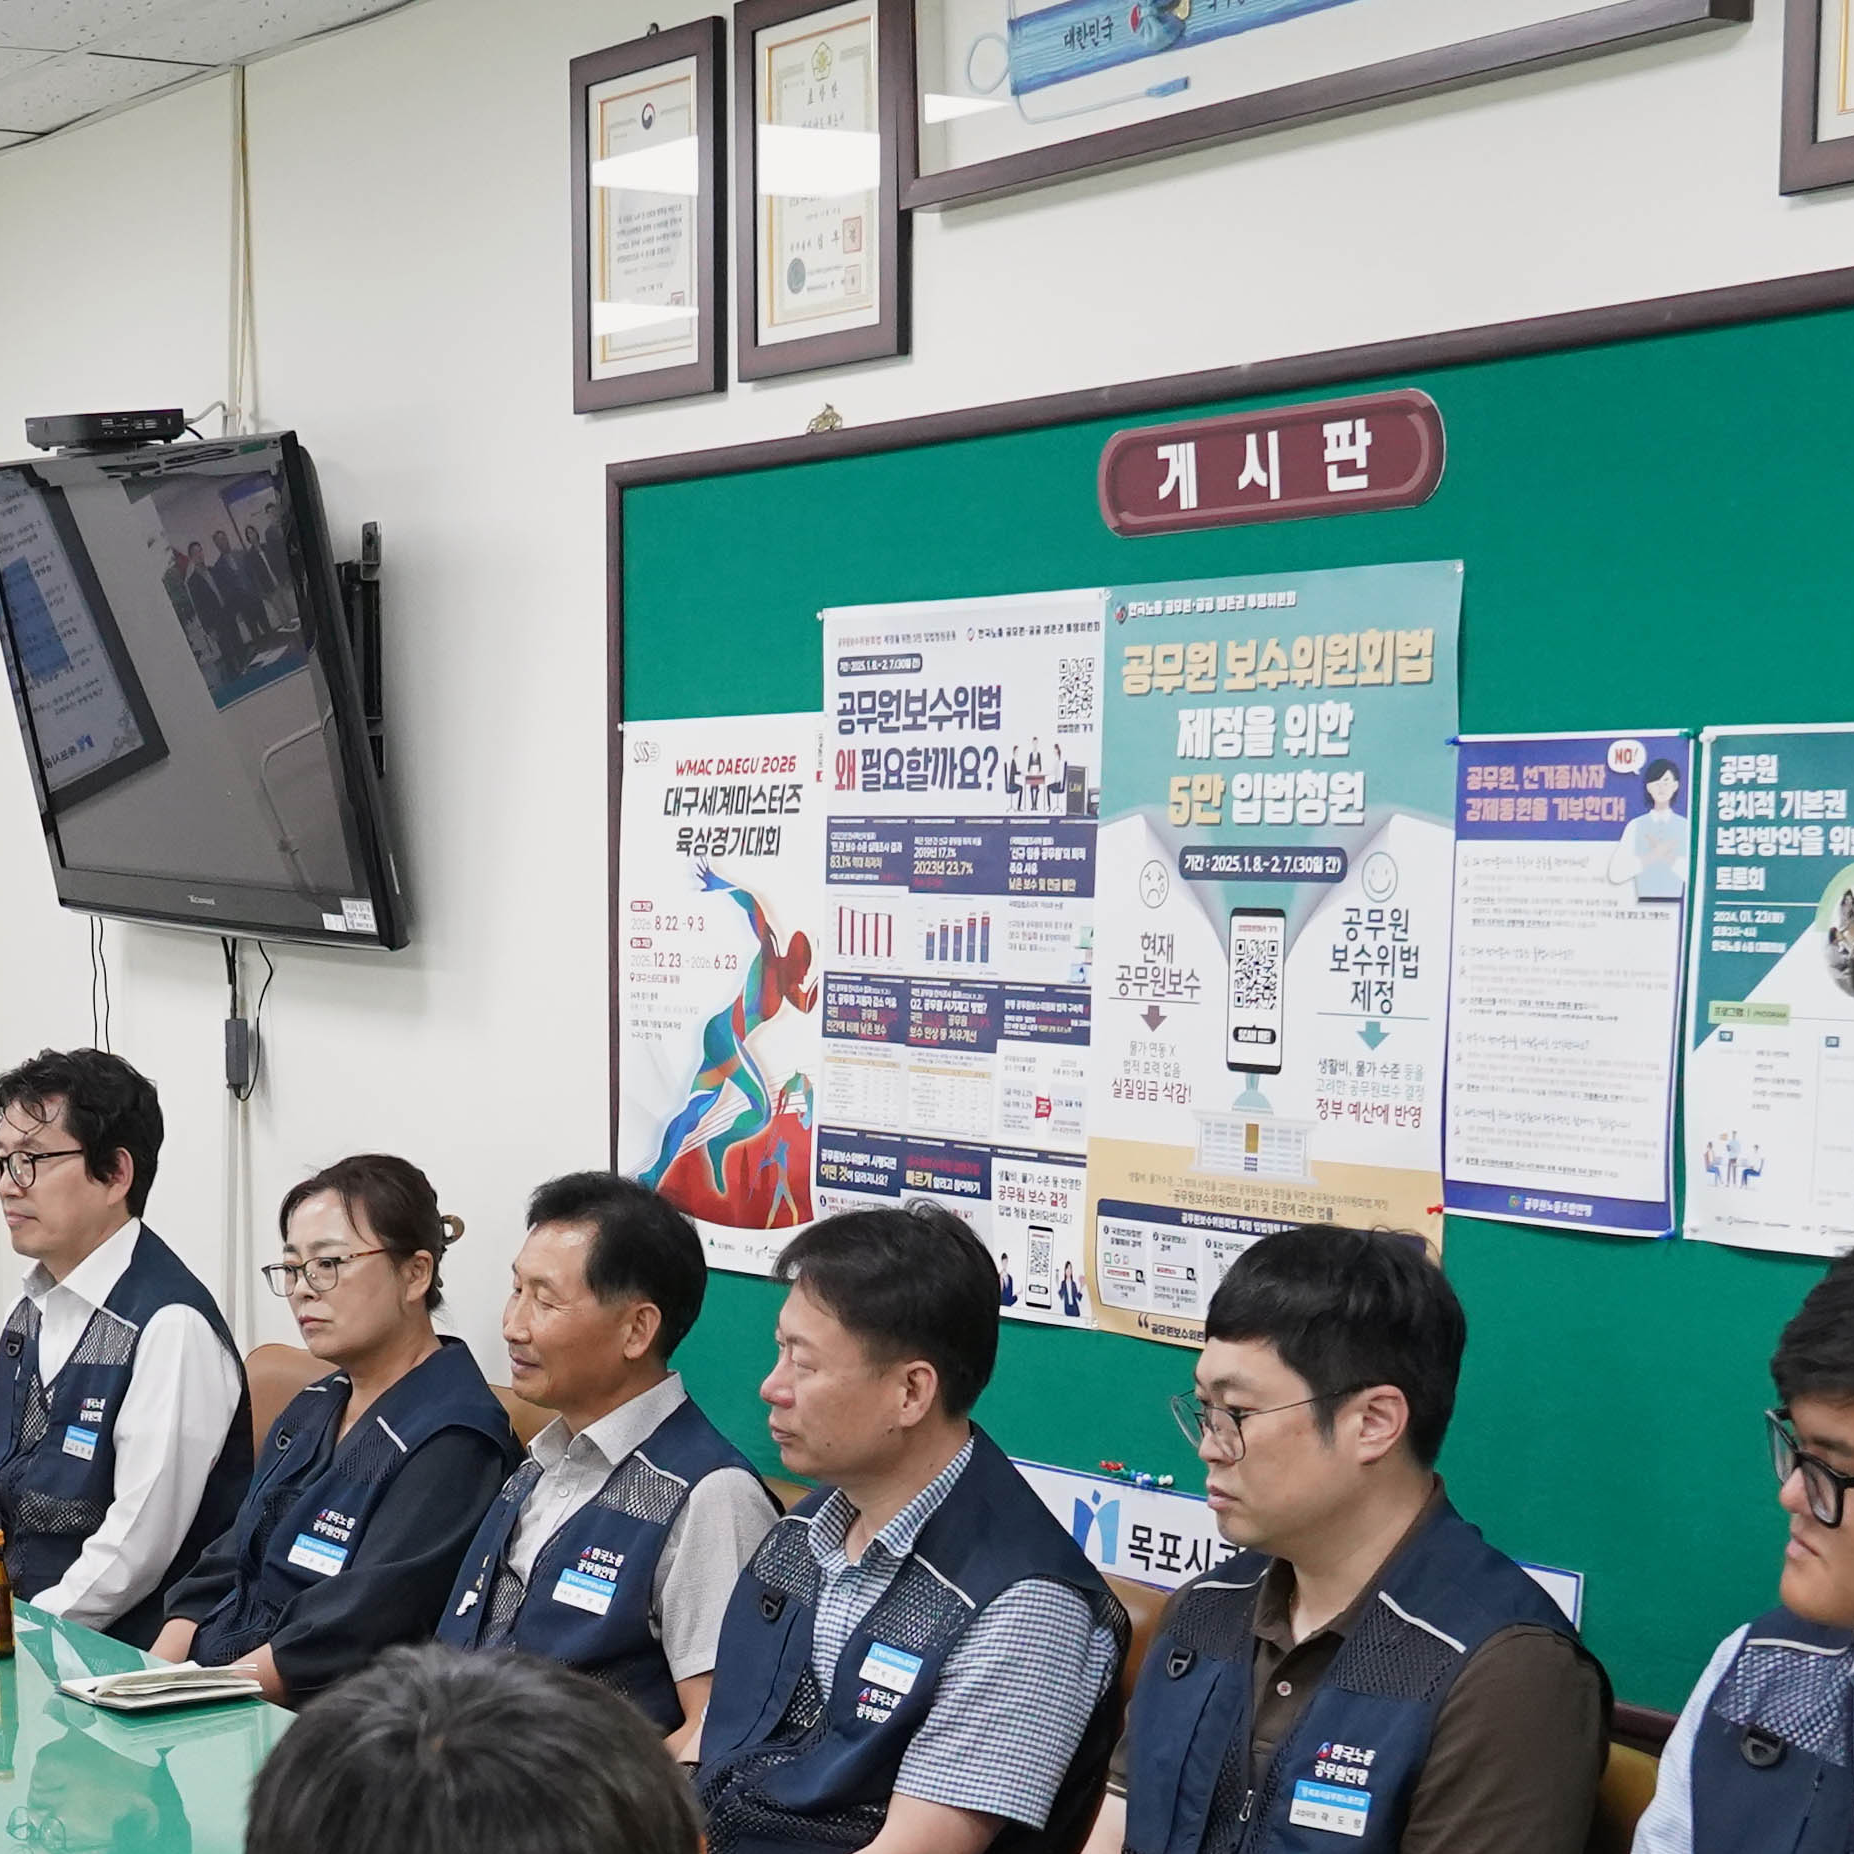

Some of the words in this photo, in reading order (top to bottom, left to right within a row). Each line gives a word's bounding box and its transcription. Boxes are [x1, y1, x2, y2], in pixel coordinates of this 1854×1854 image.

[1062, 15, 1115, 50] 대한민국
[1157, 426, 1374, 513] 게시판
[1121, 641, 1218, 695] 공무원
[1224, 628, 1434, 691] 보수위원회법
[837, 685, 1002, 735] 공무원보수위법
[1176, 705, 1276, 758] 제정을
[1282, 700, 1354, 758] 위한
[675, 758, 713, 776] WMAC
[716, 757, 760, 775] DAEGU
[762, 755, 797, 773] 2026
[835, 748, 856, 792] 왜
[861, 745, 999, 792] 필요할까요?
[1466, 765, 1520, 792] 공무원,
[1720, 754, 1779, 786] 공무원
[664, 784, 803, 816] 대구세계마스터즈
[1168, 773, 1226, 826] 5만
[1231, 769, 1365, 824] 입법청원
[1553, 797, 1626, 822] 거부한다!
[1717, 790, 1776, 821] 정치적
[1780, 789, 1847, 820] 기본권
[676, 826, 782, 857] 육상경기대회
[1716, 825, 1825, 857] 보장방안을
[1715, 866, 1766, 891] 토론회
[1342, 907, 1410, 943] 공무원
[1140, 931, 1174, 964] 현재
[1329, 944, 1420, 980] 보수위법
[1115, 964, 1201, 1000] 공무원보수
[1350, 980, 1395, 1015] 제정
[1379, 1061, 1401, 1080] 수준
[1111, 1078, 1159, 1102] 실질임금
[1163, 1082, 1192, 1105] 삭감!
[1316, 1097, 1343, 1122] 정부
[1346, 1101, 1390, 1126] 예산에
[1394, 1104, 1422, 1128] 반영
[998, 1185, 1026, 1203] 공무원
[1028, 1187, 1047, 1205] 보수
[1049, 1190, 1068, 1208] 결정
[326, 1510, 356, 1530] 한국노총
[577, 1558, 619, 1582] 공무원연맹
[591, 1547, 625, 1568] 한국노총
[856, 1703, 892, 1724] 공무원연
[869, 1688, 902, 1709] 한국노총
[1331, 1743, 1377, 1767] 한국노총
[1315, 1760, 1370, 1786] 공무원연맹
